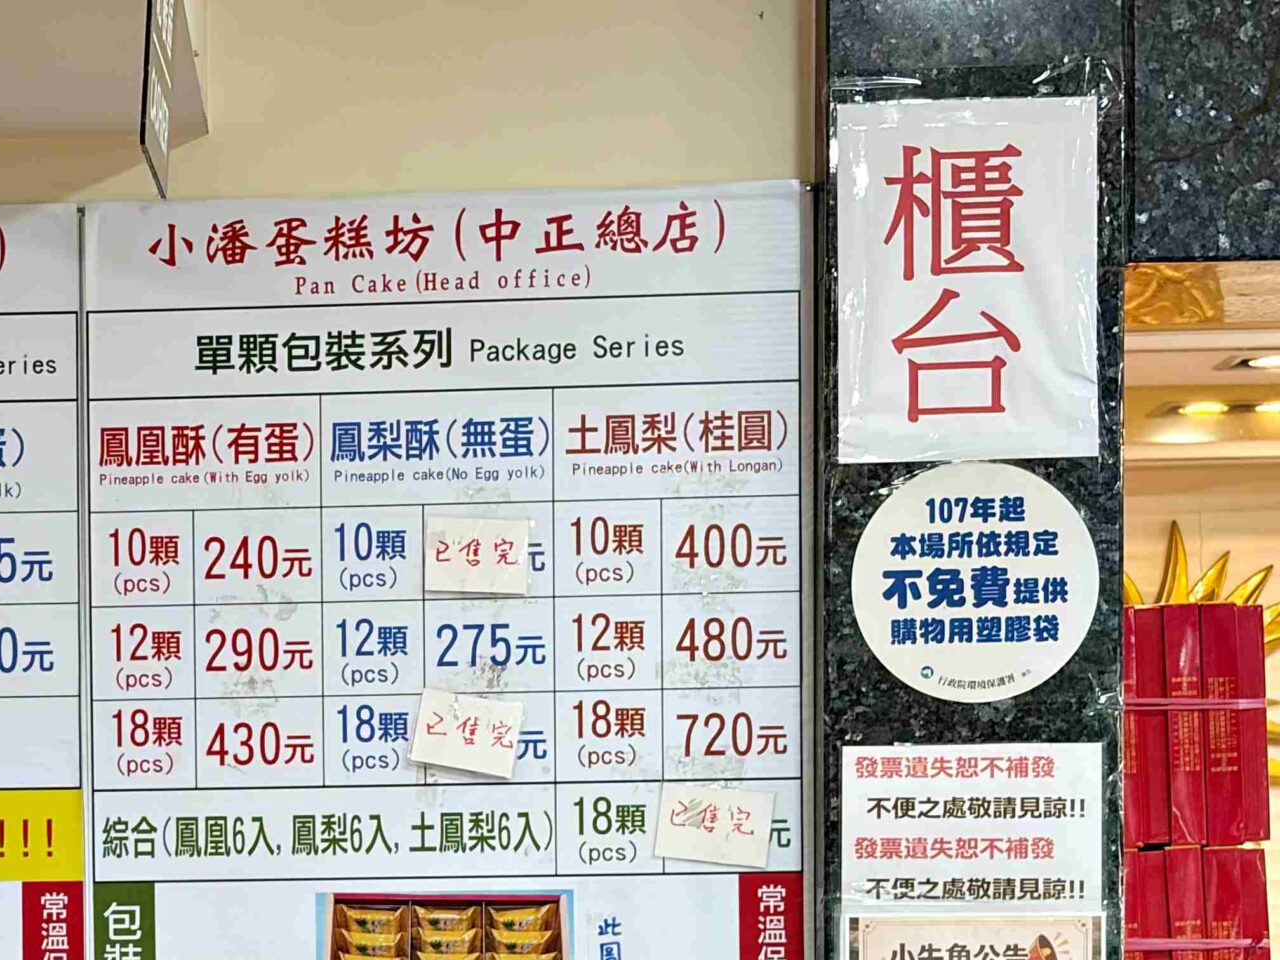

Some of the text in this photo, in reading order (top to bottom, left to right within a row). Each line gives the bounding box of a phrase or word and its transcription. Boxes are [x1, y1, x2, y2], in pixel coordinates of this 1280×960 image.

[146, 199, 729, 270] 小潘蛋糕坊(中正總店)
[293, 274, 336, 296] Pan
[497, 265, 592, 290] office)
[883, 143, 1025, 424] 櫃台
[194, 326, 686, 375] 單顆包裝系列 Package Series
[98, 421, 315, 468] 鳳凰酥(有蛋)
[330, 415, 552, 463] 鳳梨酥(無蛋)
[566, 409, 790, 456] 土鳳梨(桂圓)
[98, 470, 168, 487] Pineapple
[245, 468, 269, 485] Egg
[273, 466, 310, 484] yolk)
[333, 467, 406, 484] Pineapple
[474, 466, 499, 482] Egg
[504, 464, 546, 482] yolk)
[571, 460, 646, 478] Pineapple
[728, 457, 784, 475] Longan)
[925, 495, 1026, 524] 107年起
[106, 525, 182, 568] 10顆
[333, 521, 409, 563] 10顆
[569, 515, 646, 557] 10顆
[673, 522, 789, 570] 400元
[890, 529, 1060, 560] 本場所依規定
[202, 533, 315, 582] 240元
[574, 561, 636, 584] (pcs)
[109, 620, 184, 664] 12顆
[203, 625, 316, 673] 290元
[334, 616, 410, 660] 12顆
[434, 622, 548, 669] 275元
[571, 612, 647, 654] 12顆
[674, 615, 790, 664] 480元
[890, 614, 1060, 645] 購物用塑膠袋
[110, 707, 185, 749] 18顆
[336, 703, 410, 745] 18顆
[572, 699, 648, 741] 18顆
[675, 710, 790, 758] 720元
[204, 721, 316, 768] 430元
[854, 756, 1056, 780] 發票遺失恕不補發
[572, 795, 649, 838] 18顆
[866, 797, 1086, 820] 不便之處敬請見諒!!
[854, 837, 1056, 860] 發票遺失恕不補發
[866, 877, 1086, 900] 不便之處敬請見諒!!
